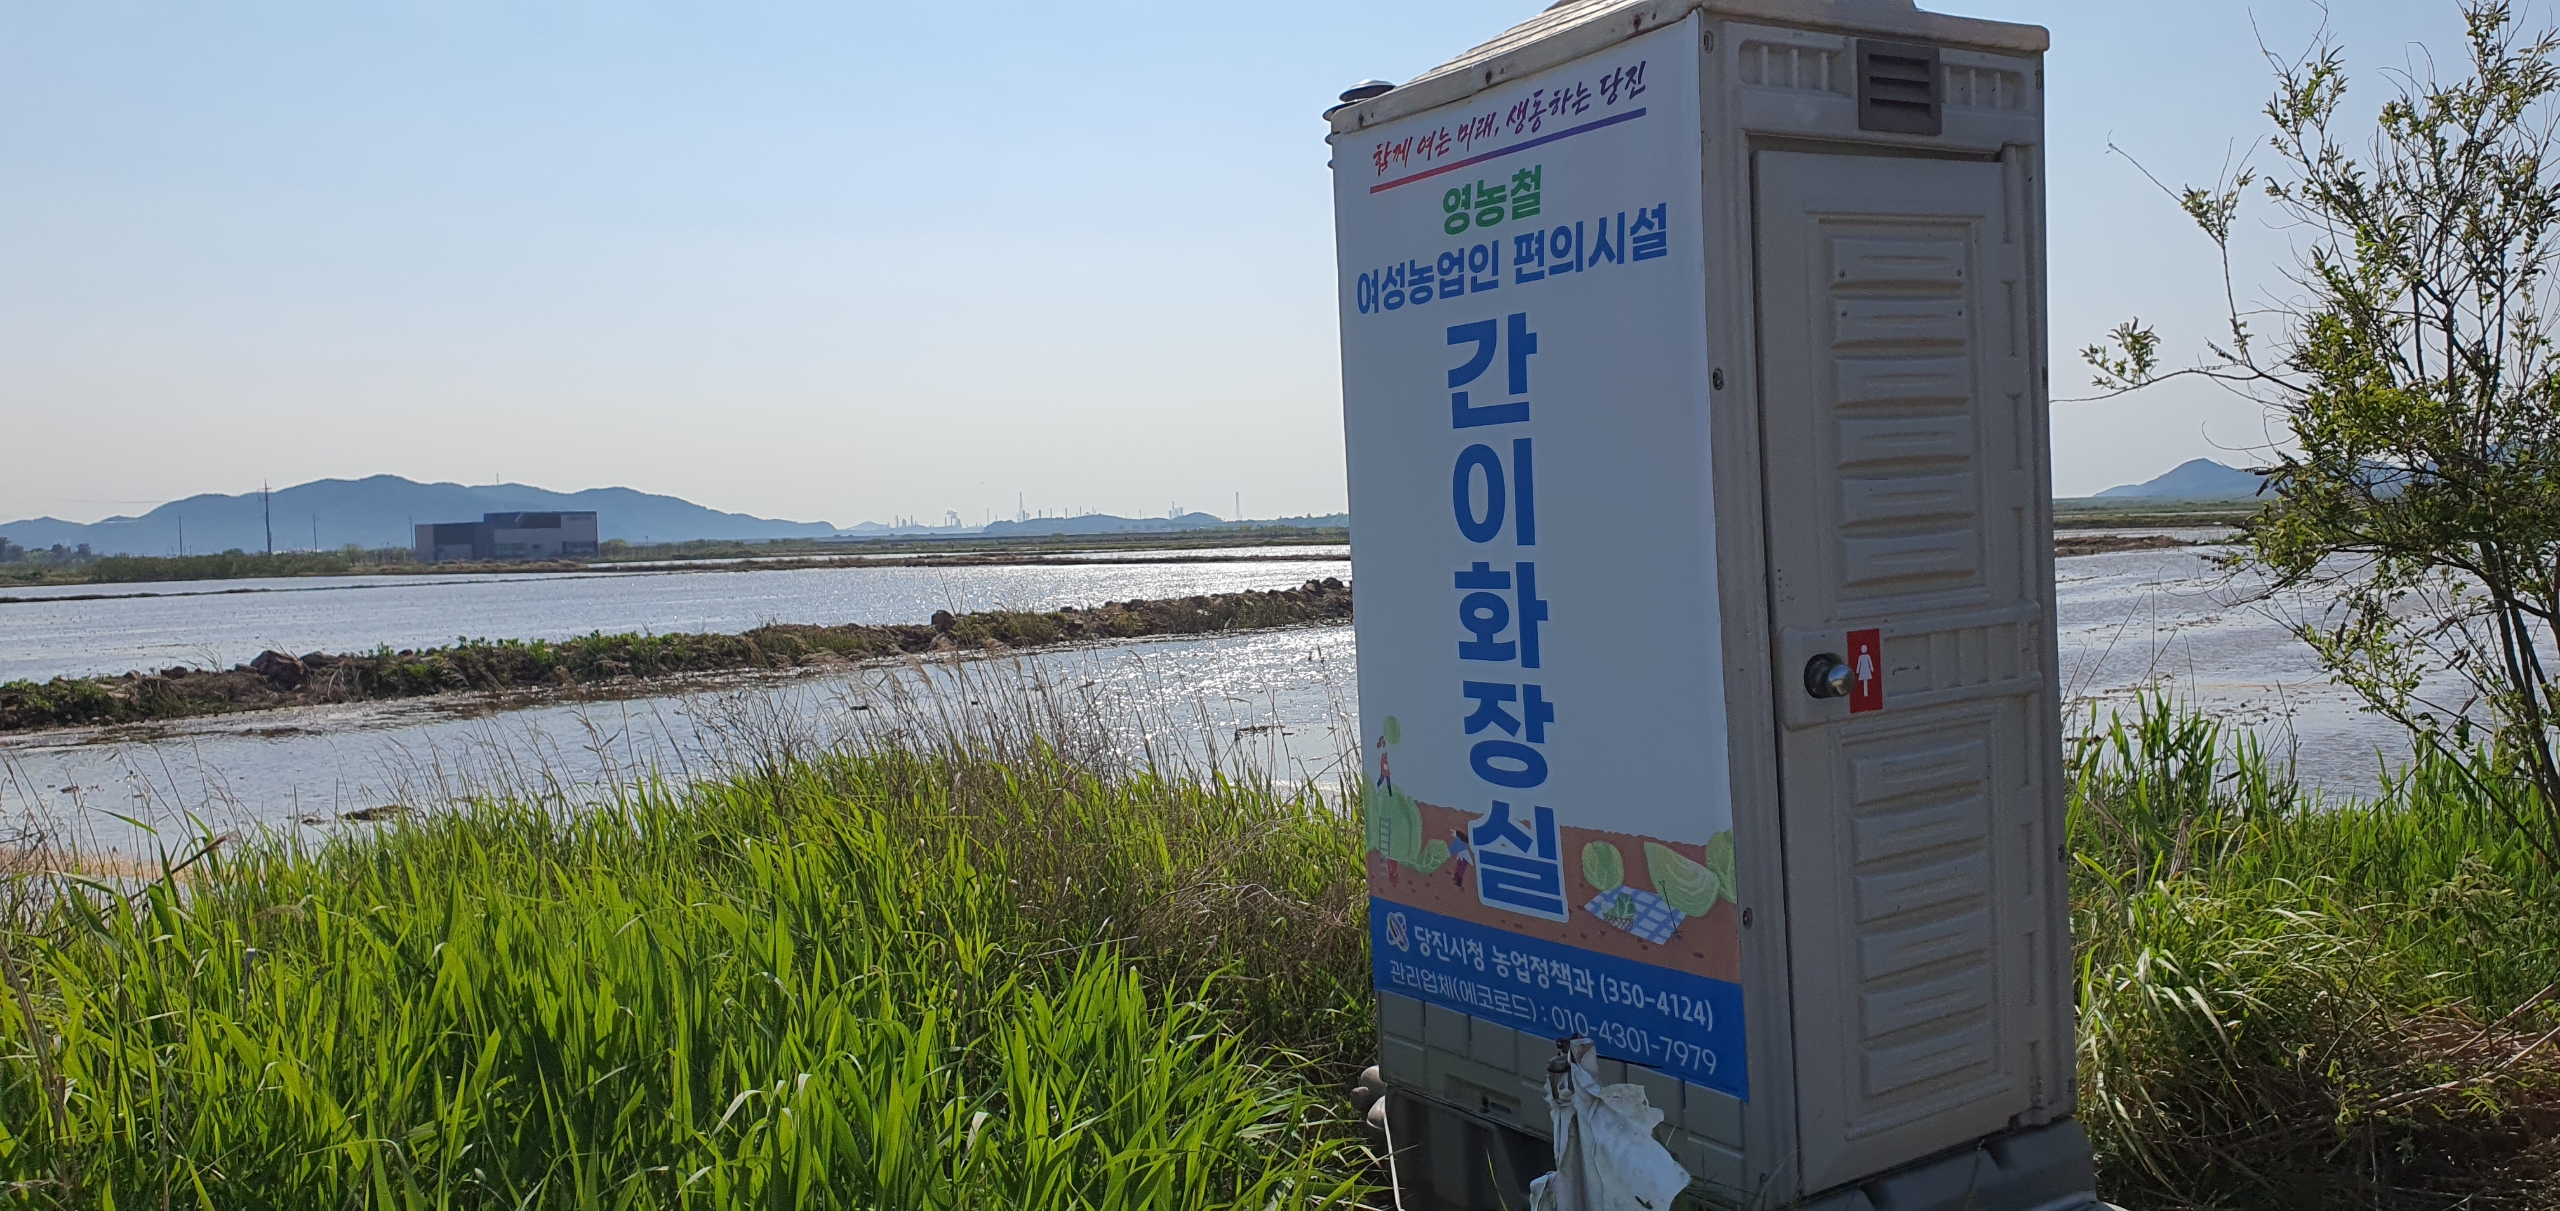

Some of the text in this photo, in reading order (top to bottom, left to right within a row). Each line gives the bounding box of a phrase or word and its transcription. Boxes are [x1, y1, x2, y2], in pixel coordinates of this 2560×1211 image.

[1373, 60, 1646, 176] 함께 여는 미래, 생동하는 당진
[1443, 165, 1542, 235] 영농철
[1357, 202, 1667, 314] 여성농업인 편의시설
[1446, 312, 1564, 916] 간이화장실
[1390, 960, 1537, 1022] 관리업체(에코로드)
[1551, 1005, 1717, 1075] 010-4301-7979
[1414, 925, 1713, 1032] 당진시청 농업정책과 (350-4124)
